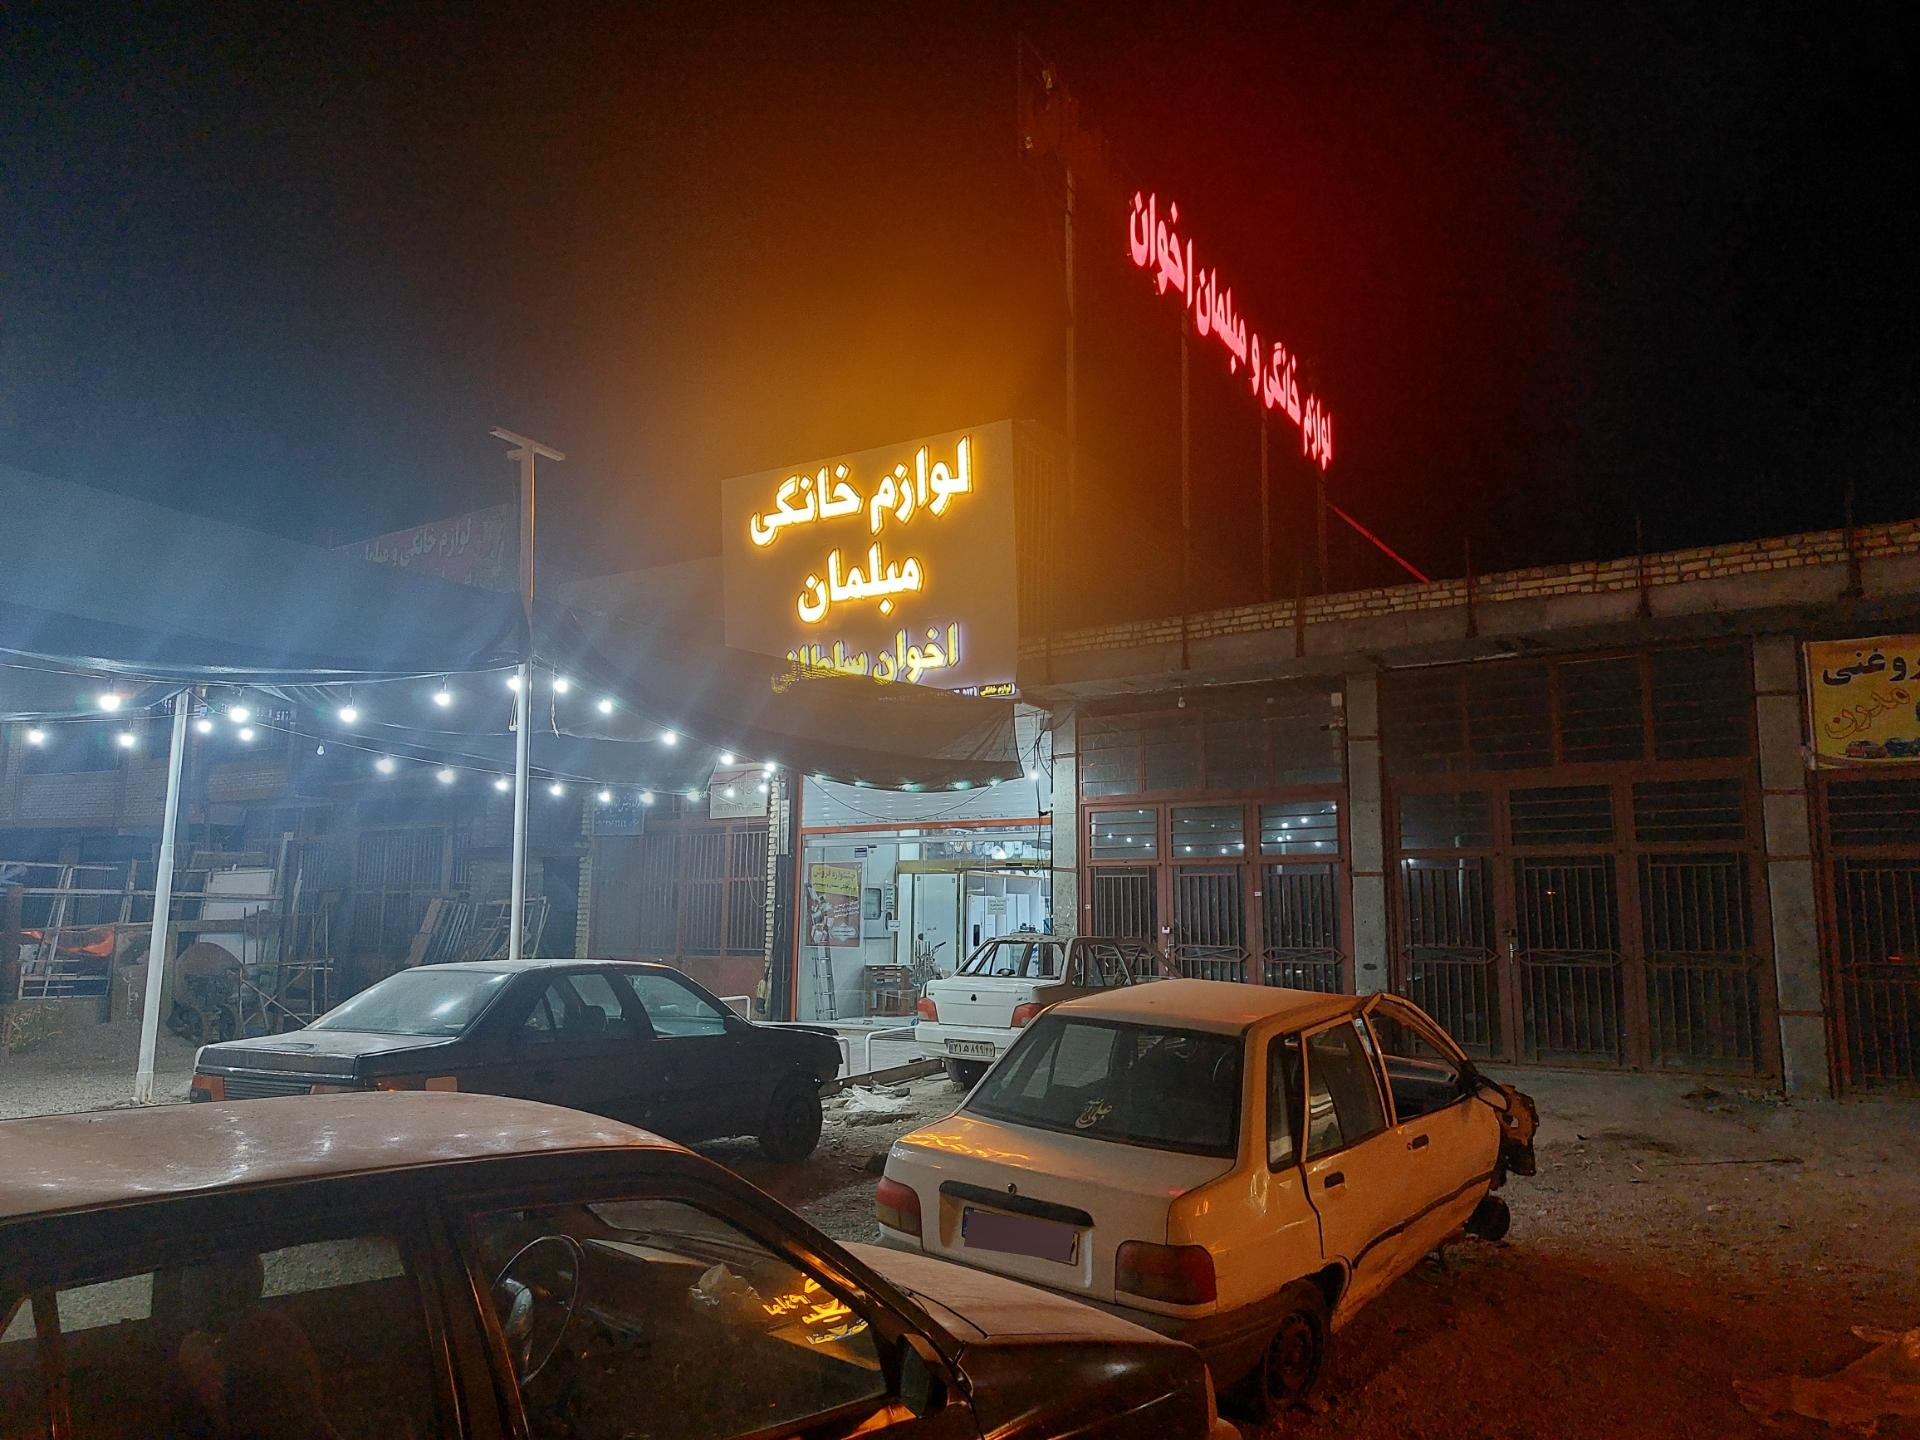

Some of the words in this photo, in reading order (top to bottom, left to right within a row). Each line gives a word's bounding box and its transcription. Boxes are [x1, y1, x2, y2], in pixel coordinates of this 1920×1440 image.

[1130, 190, 1193, 309] اخوان
[1196, 267, 1247, 375] مبلمان
[1251, 333, 1260, 396] و
[1263, 341, 1301, 426] خانگی
[1303, 392, 1332, 471] لوازم
[749, 463, 865, 547] خانگی
[869, 435, 974, 536] لوازم
[797, 541, 925, 624] مبلمان
[872, 622, 960, 684] اخوان
